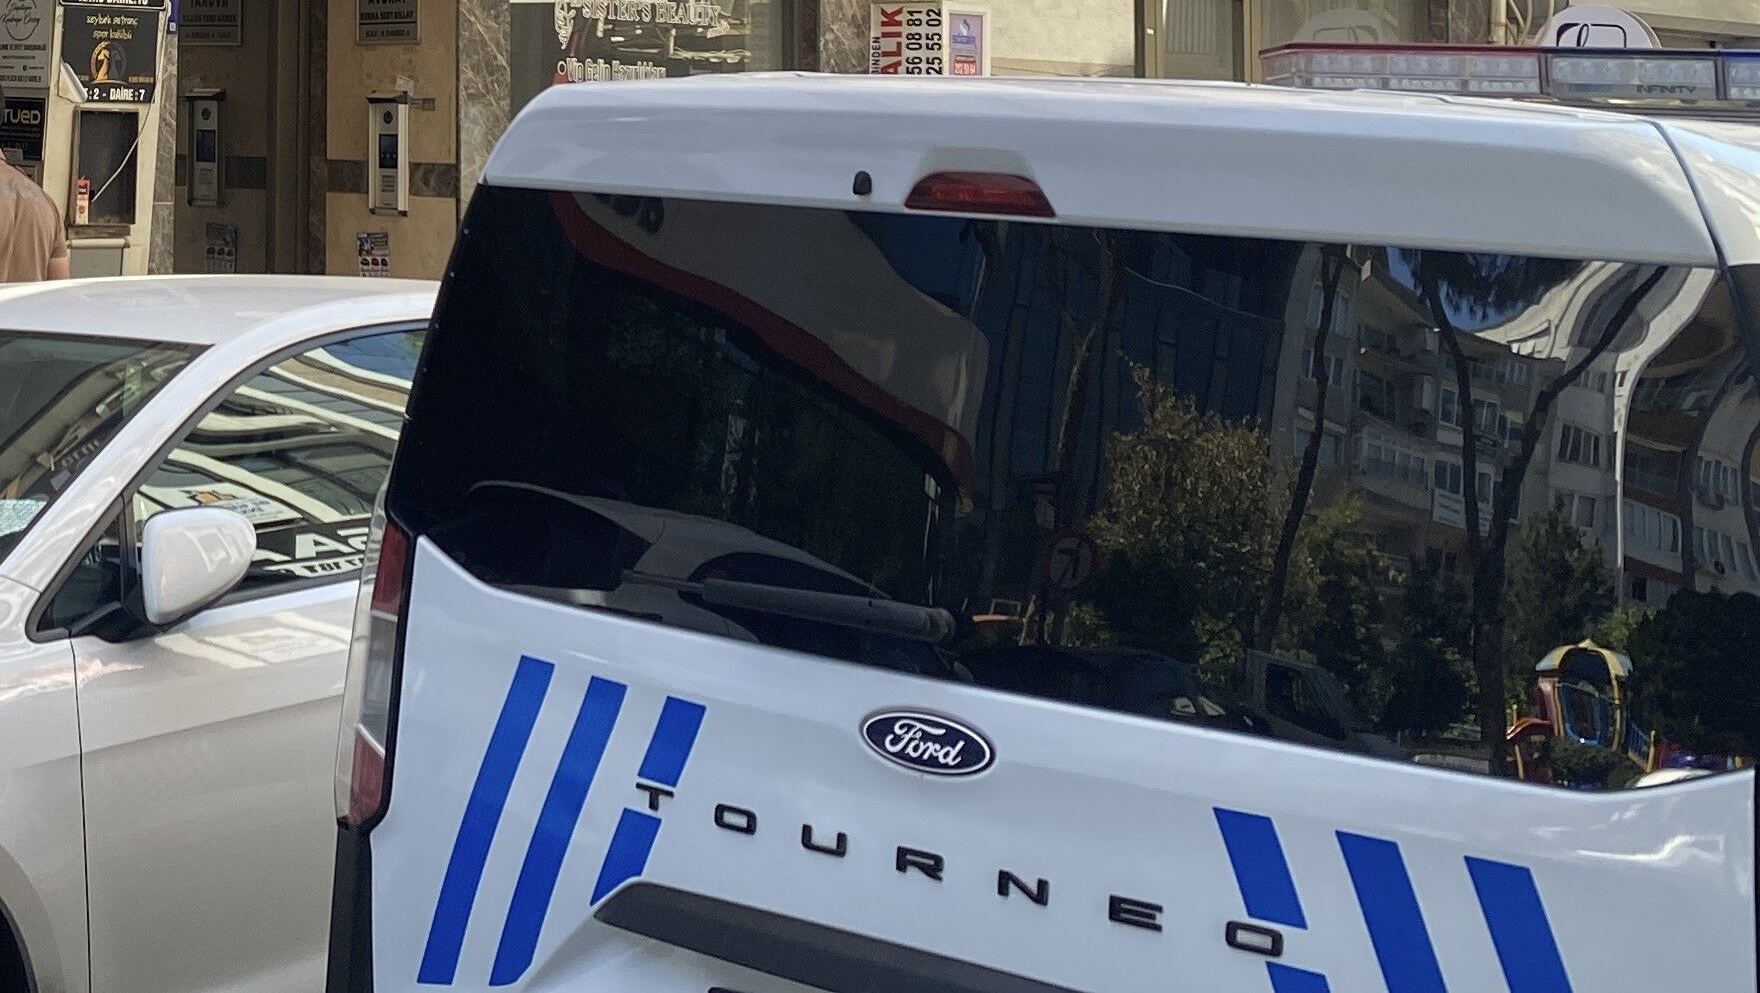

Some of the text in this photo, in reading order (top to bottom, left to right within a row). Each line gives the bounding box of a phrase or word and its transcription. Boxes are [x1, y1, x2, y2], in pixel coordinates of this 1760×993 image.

[906, 10, 923, 27] 81
[926, 9, 942, 27] 02
[906, 32, 923, 51] 08
[926, 32, 942, 51] 55
[885, 716, 964, 770] Ford
[636, 781, 1284, 959] TOURNEO
